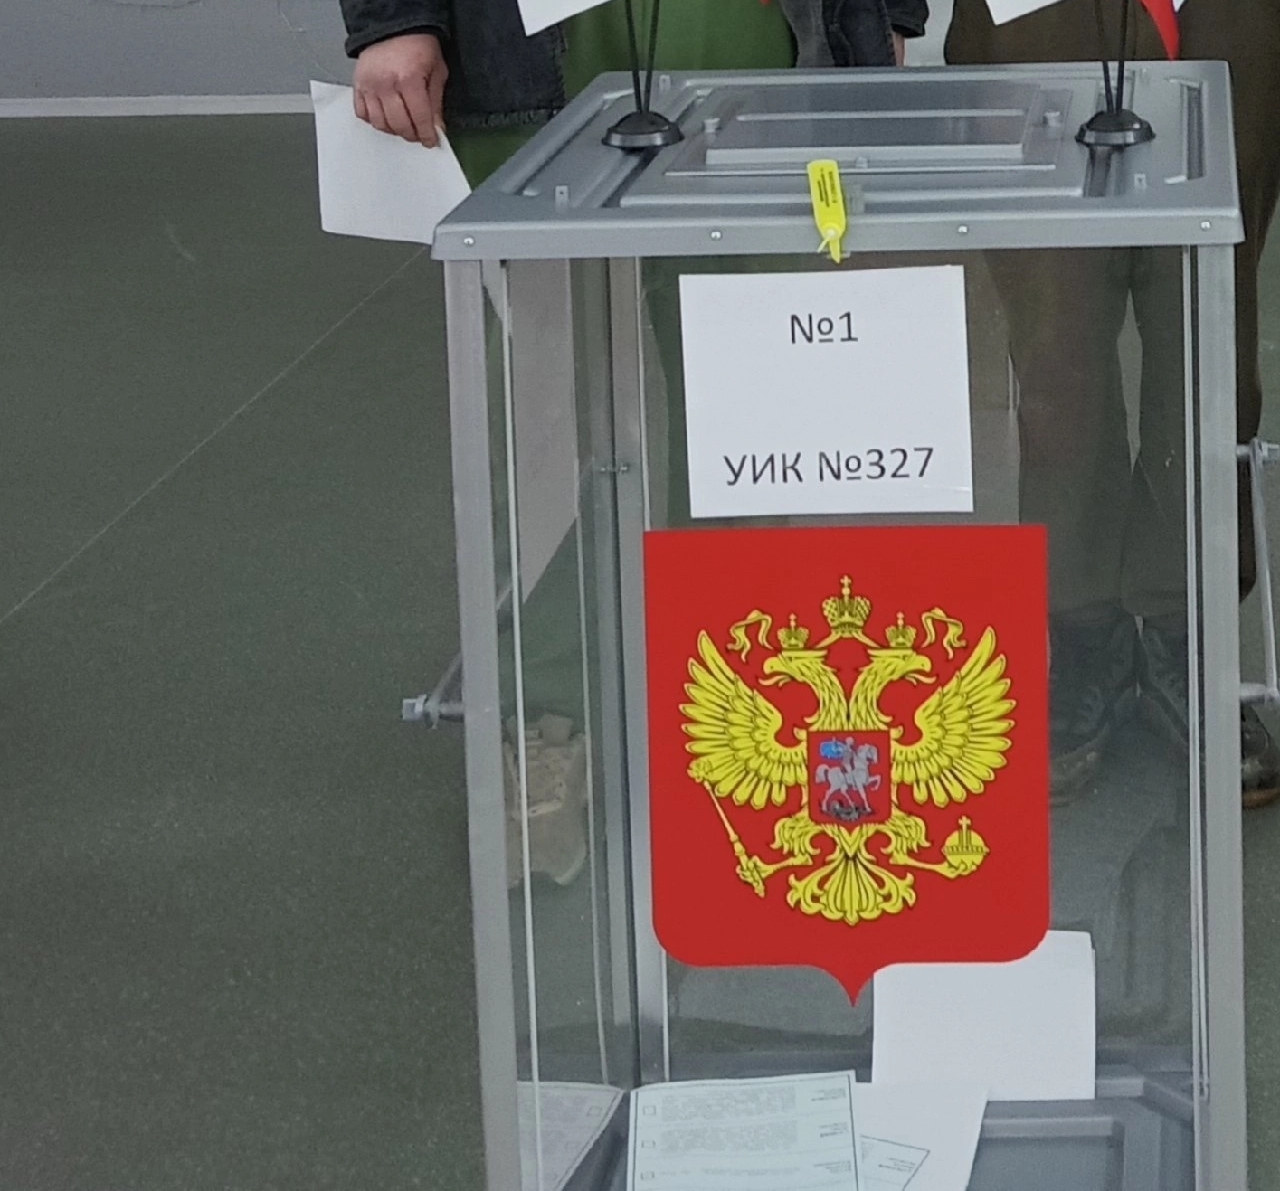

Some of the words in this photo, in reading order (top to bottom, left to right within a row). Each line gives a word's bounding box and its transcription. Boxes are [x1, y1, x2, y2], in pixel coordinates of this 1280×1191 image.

[790, 311, 859, 344] №1
[723, 452, 803, 486] УИК
[819, 447, 934, 482] №327
